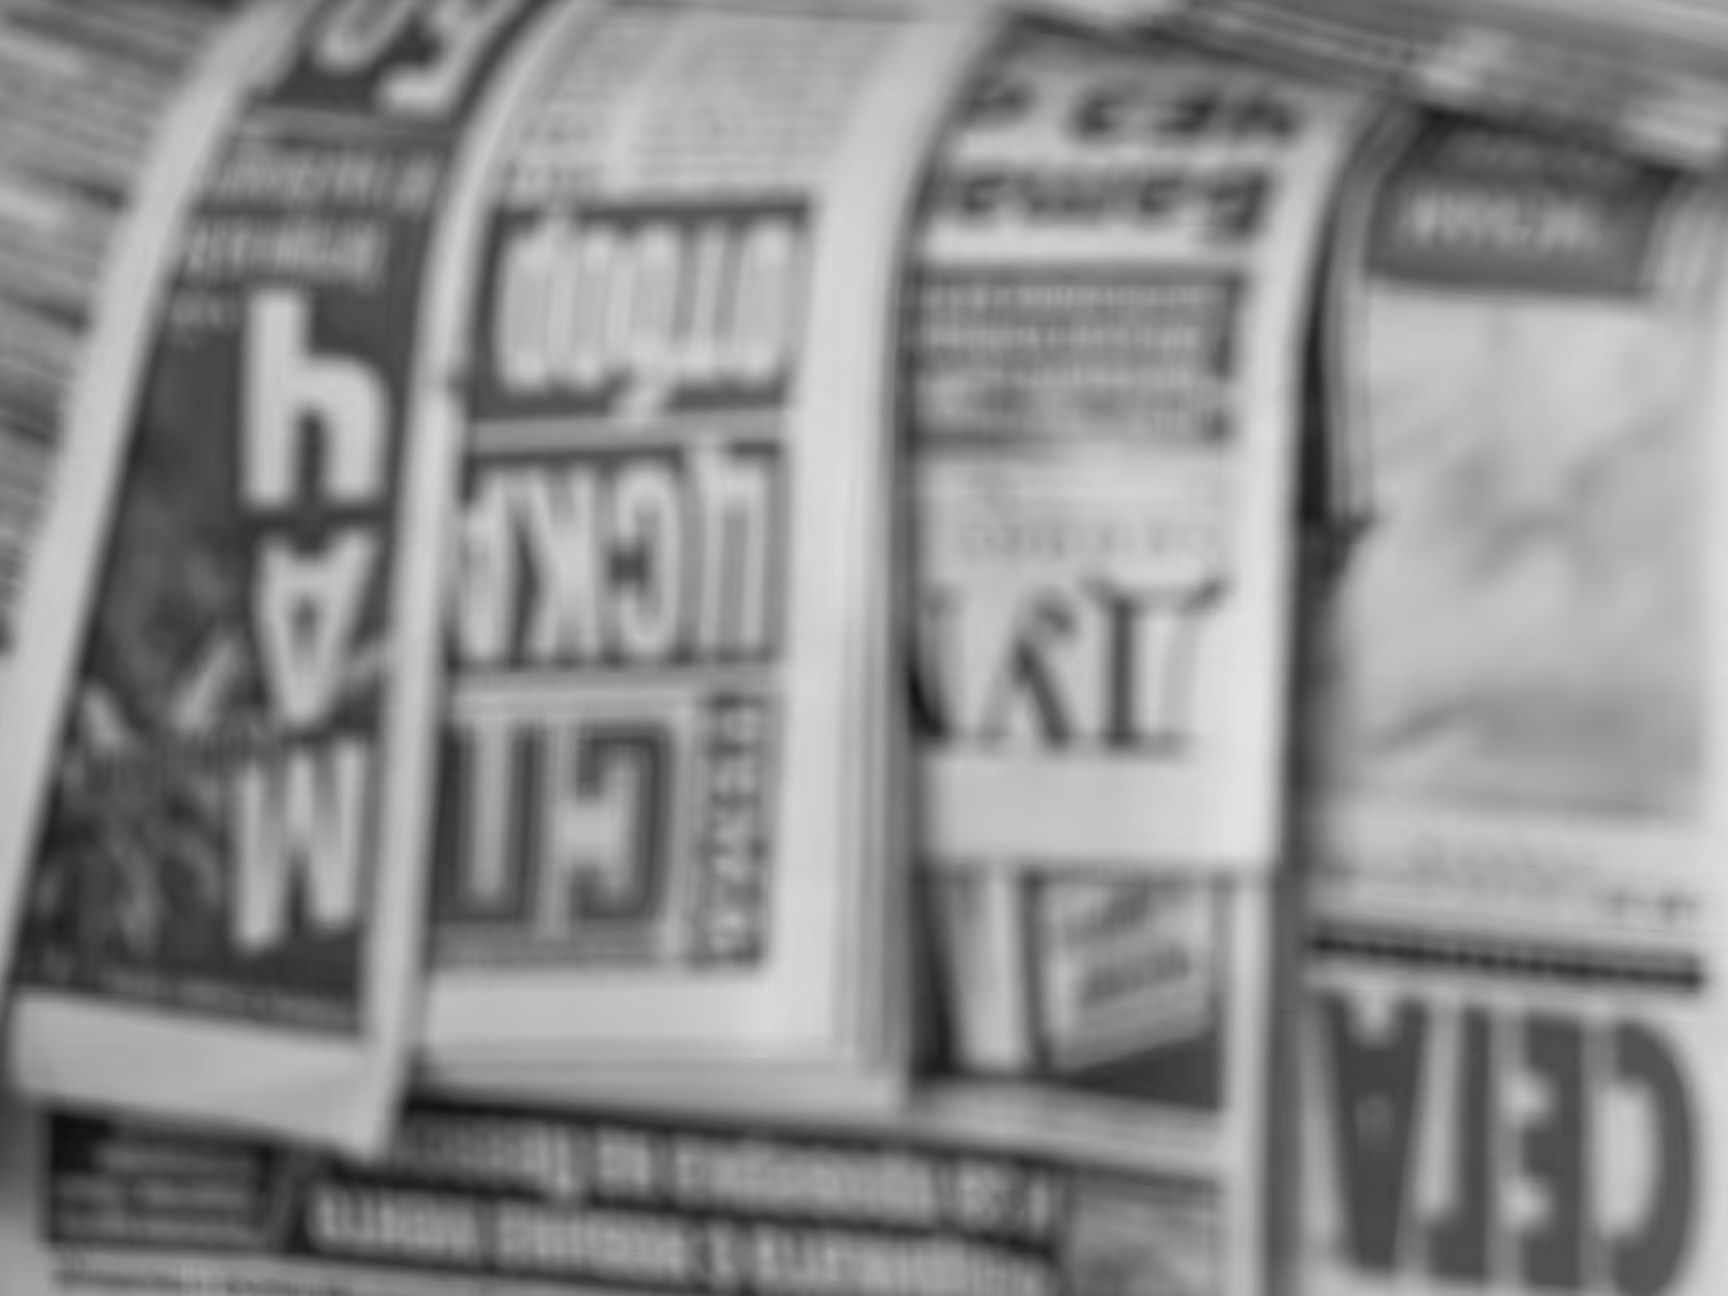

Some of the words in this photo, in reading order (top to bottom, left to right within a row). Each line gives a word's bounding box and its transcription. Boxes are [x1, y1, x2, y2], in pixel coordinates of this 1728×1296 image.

[232, 283, 384, 953] МАЧ
[451, 453, 777, 662] ЦСКА
[1298, 983, 1703, 1294] СЕГА
